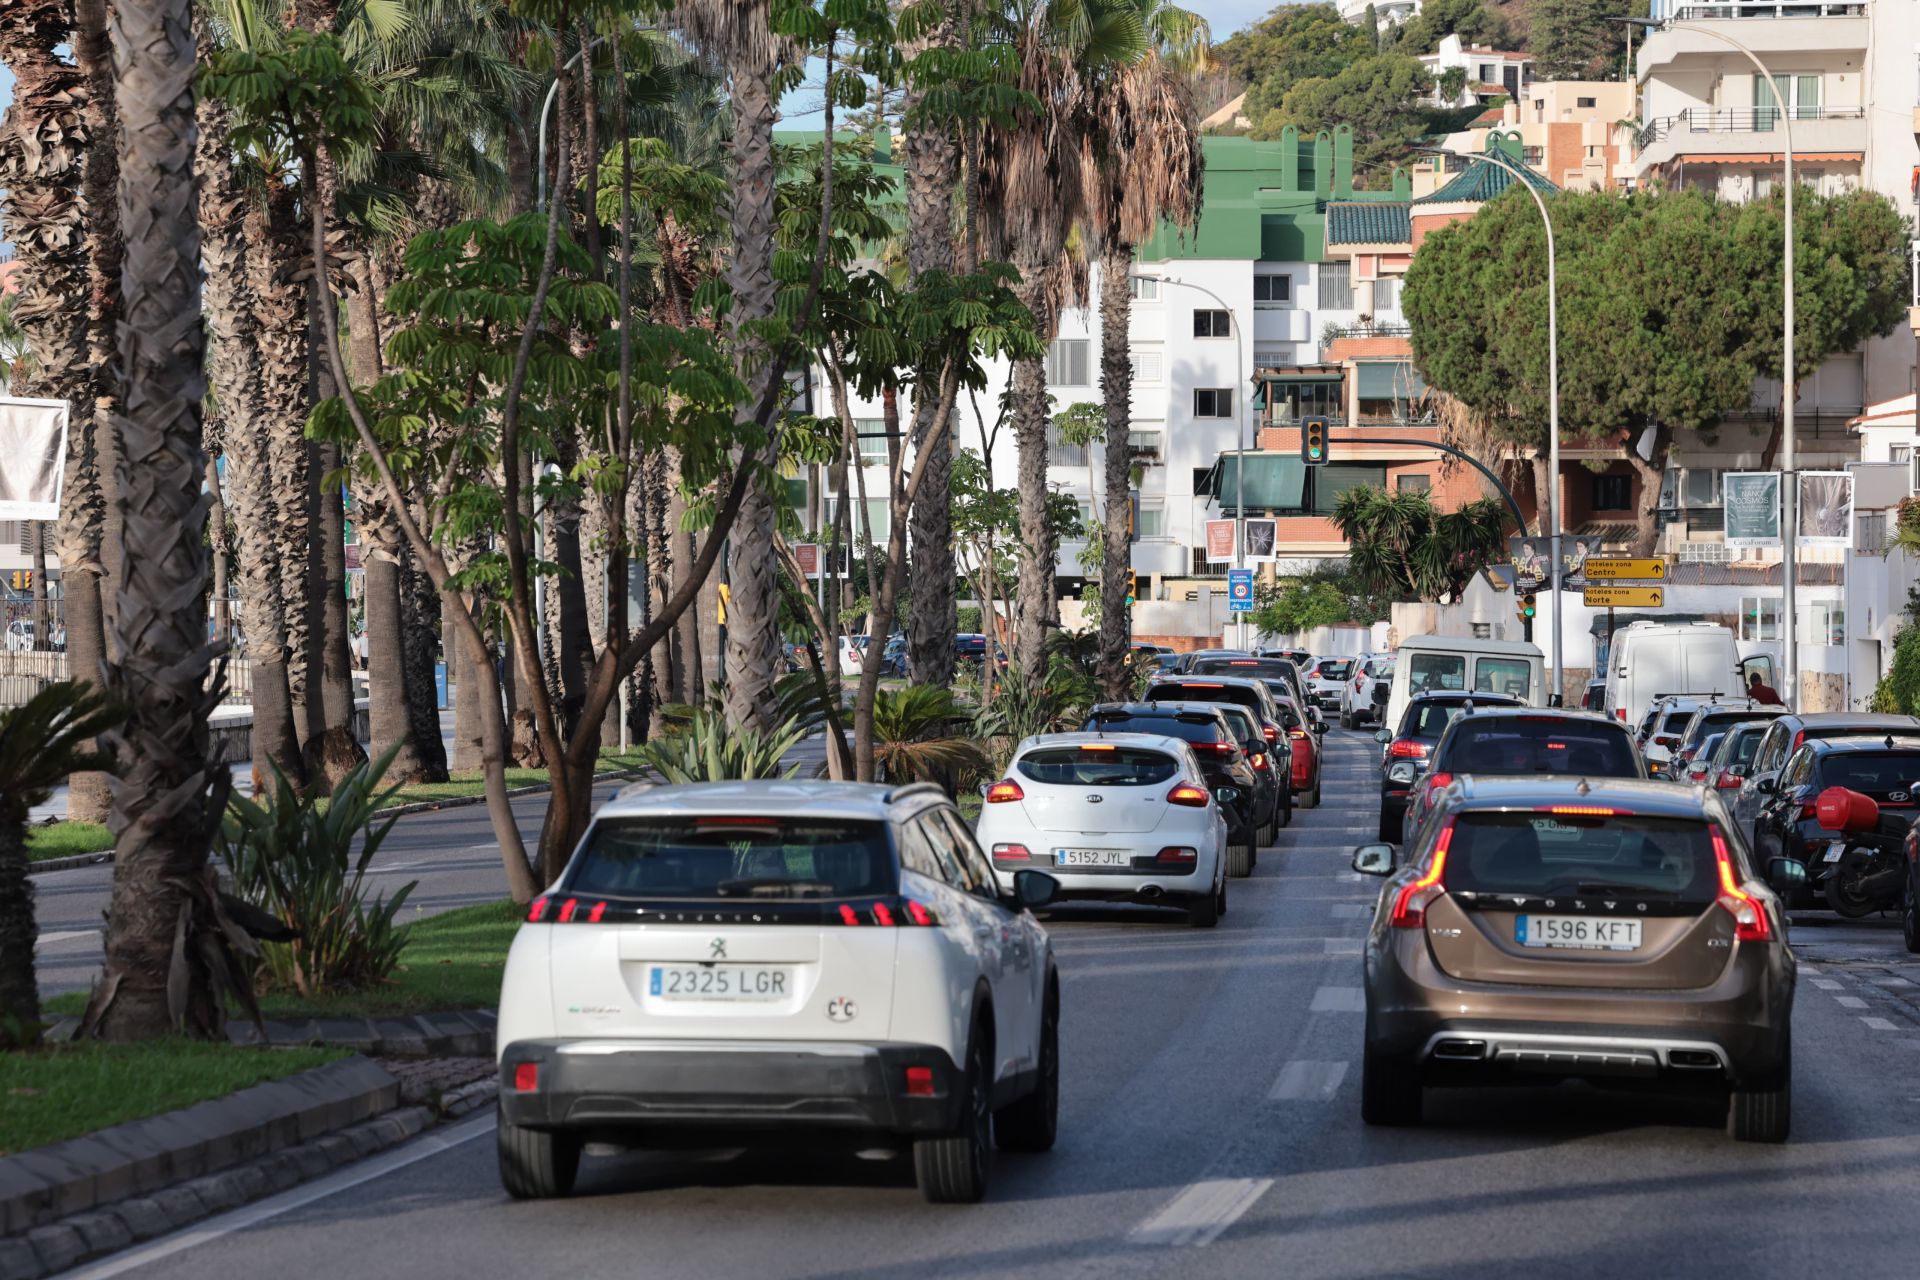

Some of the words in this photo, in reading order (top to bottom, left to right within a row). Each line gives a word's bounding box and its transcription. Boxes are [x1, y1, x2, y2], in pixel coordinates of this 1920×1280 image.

[1517, 564, 1543, 574] PHA
[1069, 853, 1099, 864] 5152
[1103, 853, 1124, 864] JYL
[1512, 897, 1647, 911] VOLVO
[1536, 919, 1588, 940] 1596
[1595, 922, 1636, 942] KFT
[668, 971, 729, 993] 2325
[740, 971, 785, 993] LGR
